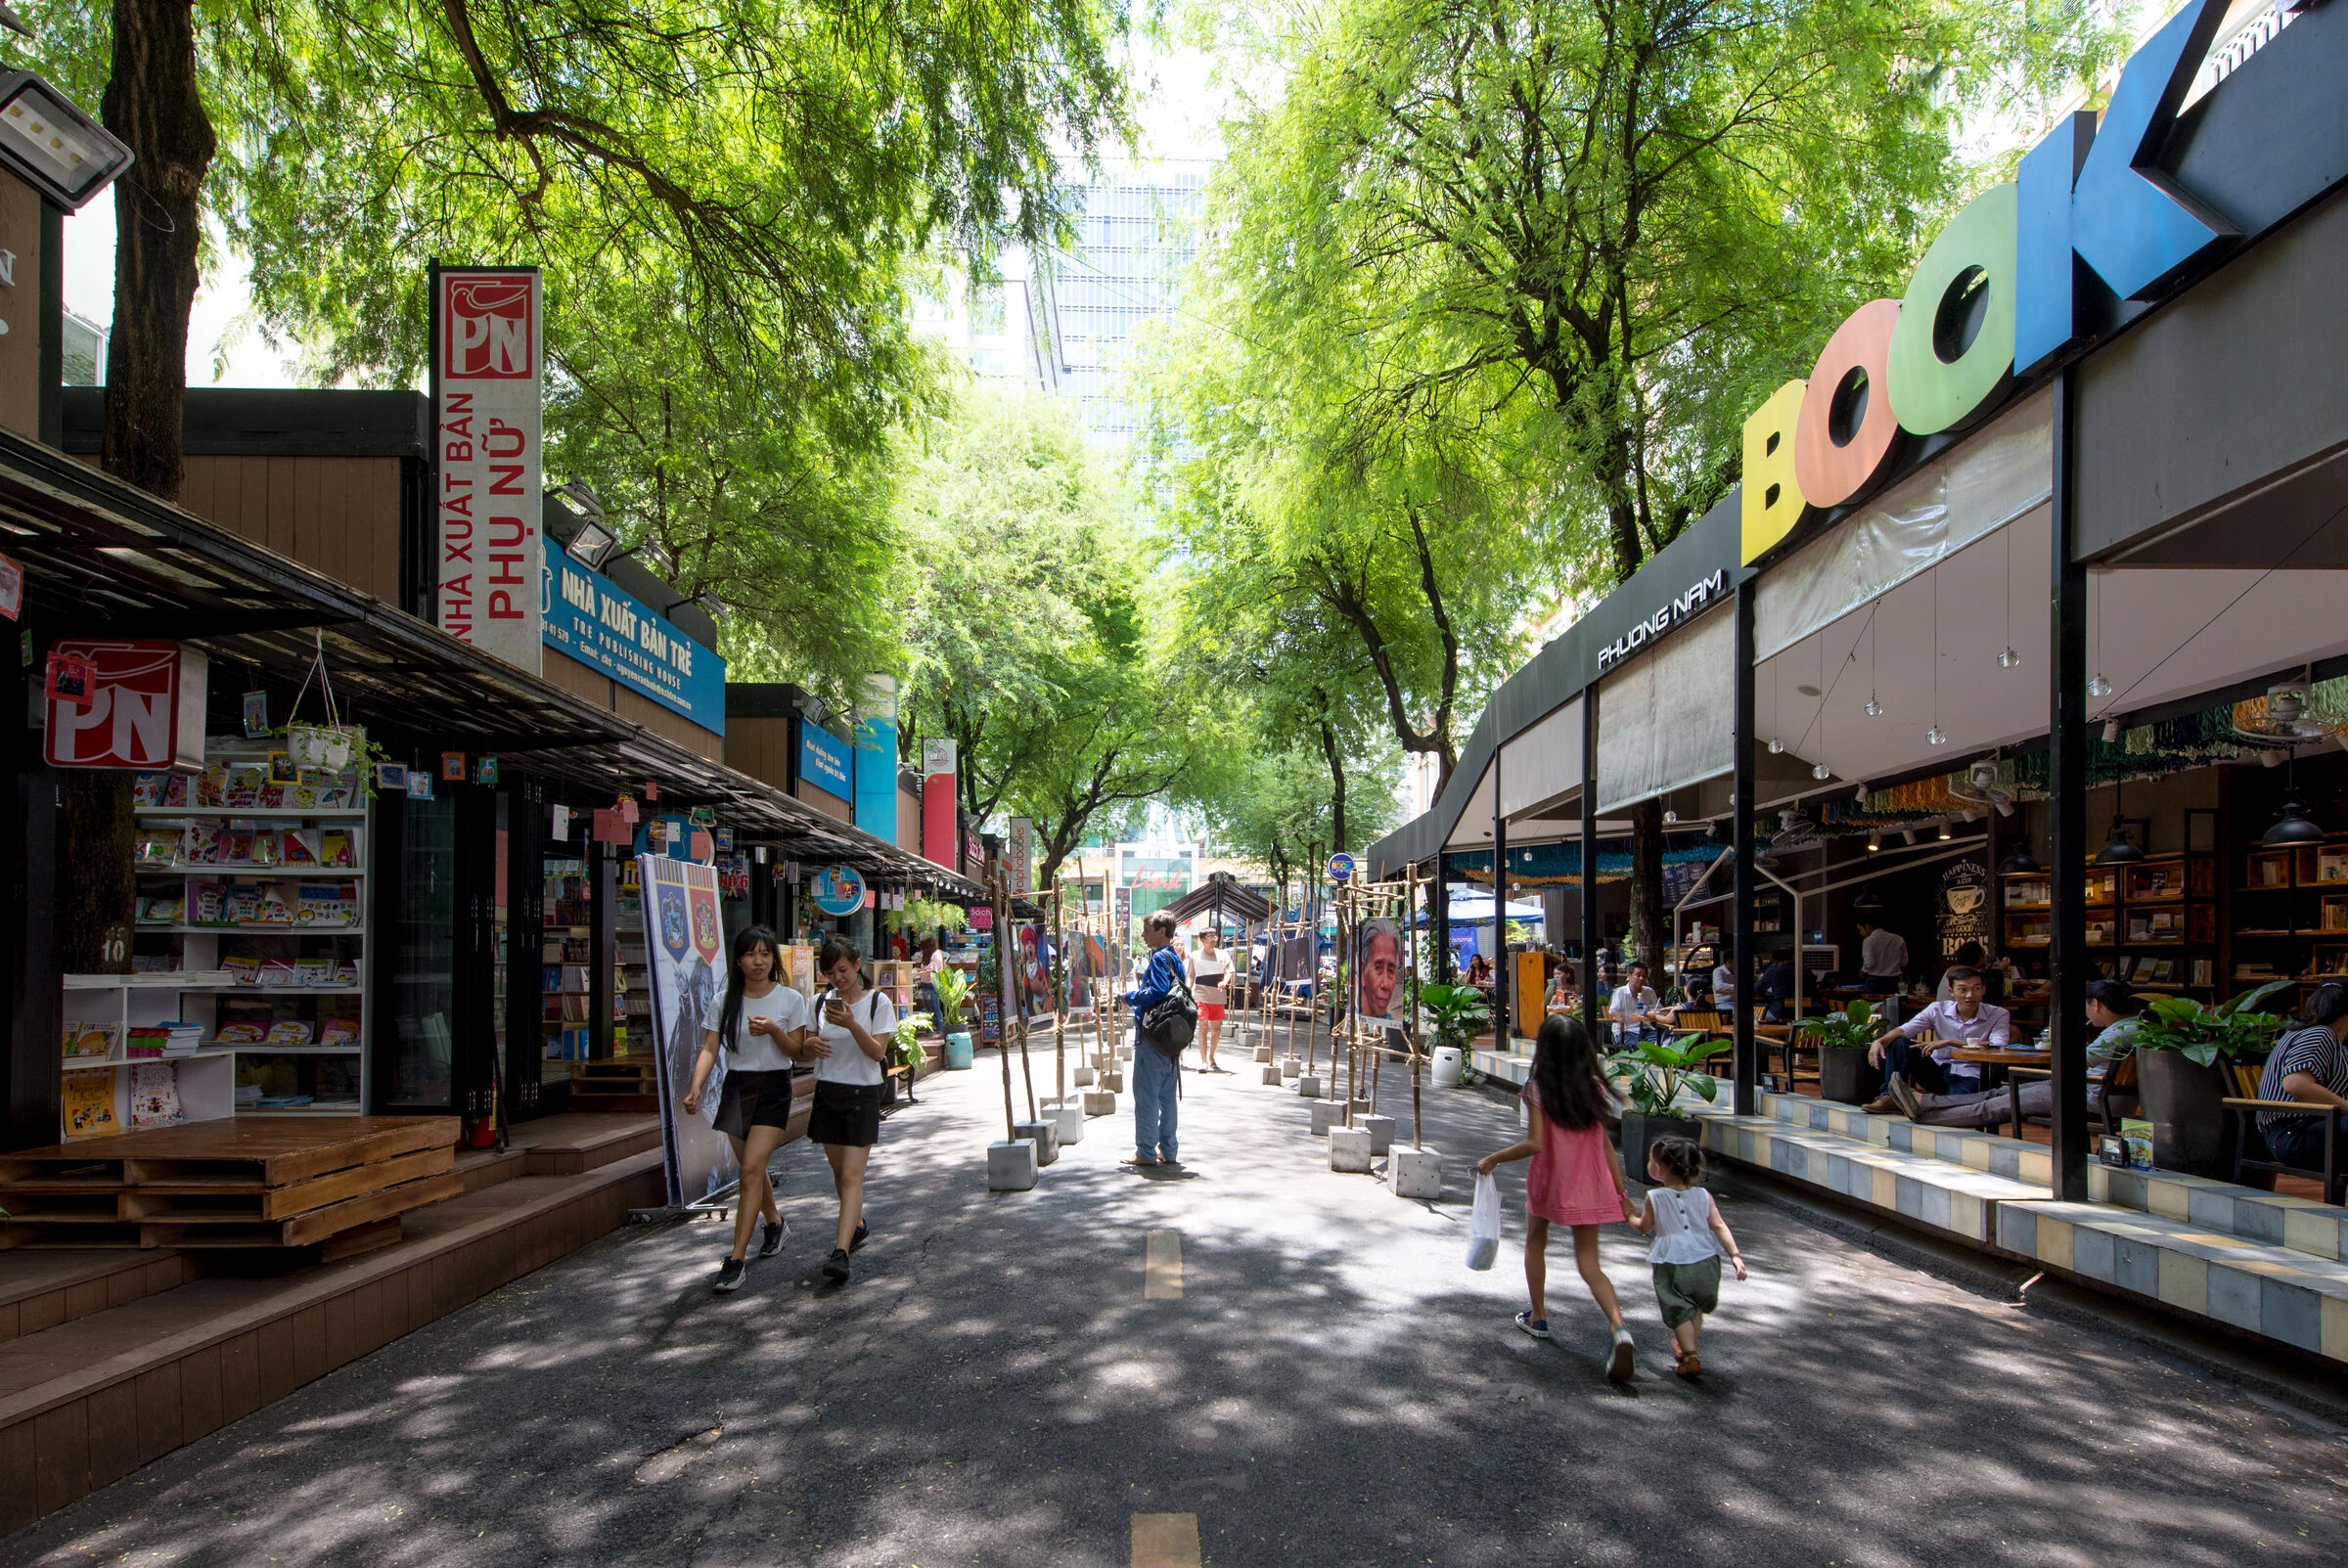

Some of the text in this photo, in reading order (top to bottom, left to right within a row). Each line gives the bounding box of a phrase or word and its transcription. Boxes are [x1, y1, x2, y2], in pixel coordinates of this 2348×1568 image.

[1741, 0, 2240, 567] BOOK
[452, 313, 527, 375] PN
[438, 393, 473, 643] NHÀ XUẤT BẢN
[481, 418, 534, 619] PHỤ NỮ
[562, 567, 693, 678] NHÀ XUẤT BẢN TRẺ
[572, 616, 681, 691] TRE PUBLISHING HOUSE
[1598, 568, 1725, 670] PHUONG NAM
[55, 683, 171, 762] PN
[1014, 827, 1027, 888] alphabooks
[1131, 865, 1184, 892] Link
[1942, 862, 1987, 881] HAPPINESS
[102, 939, 125, 963] 10
[1942, 935, 1989, 956] BOK
